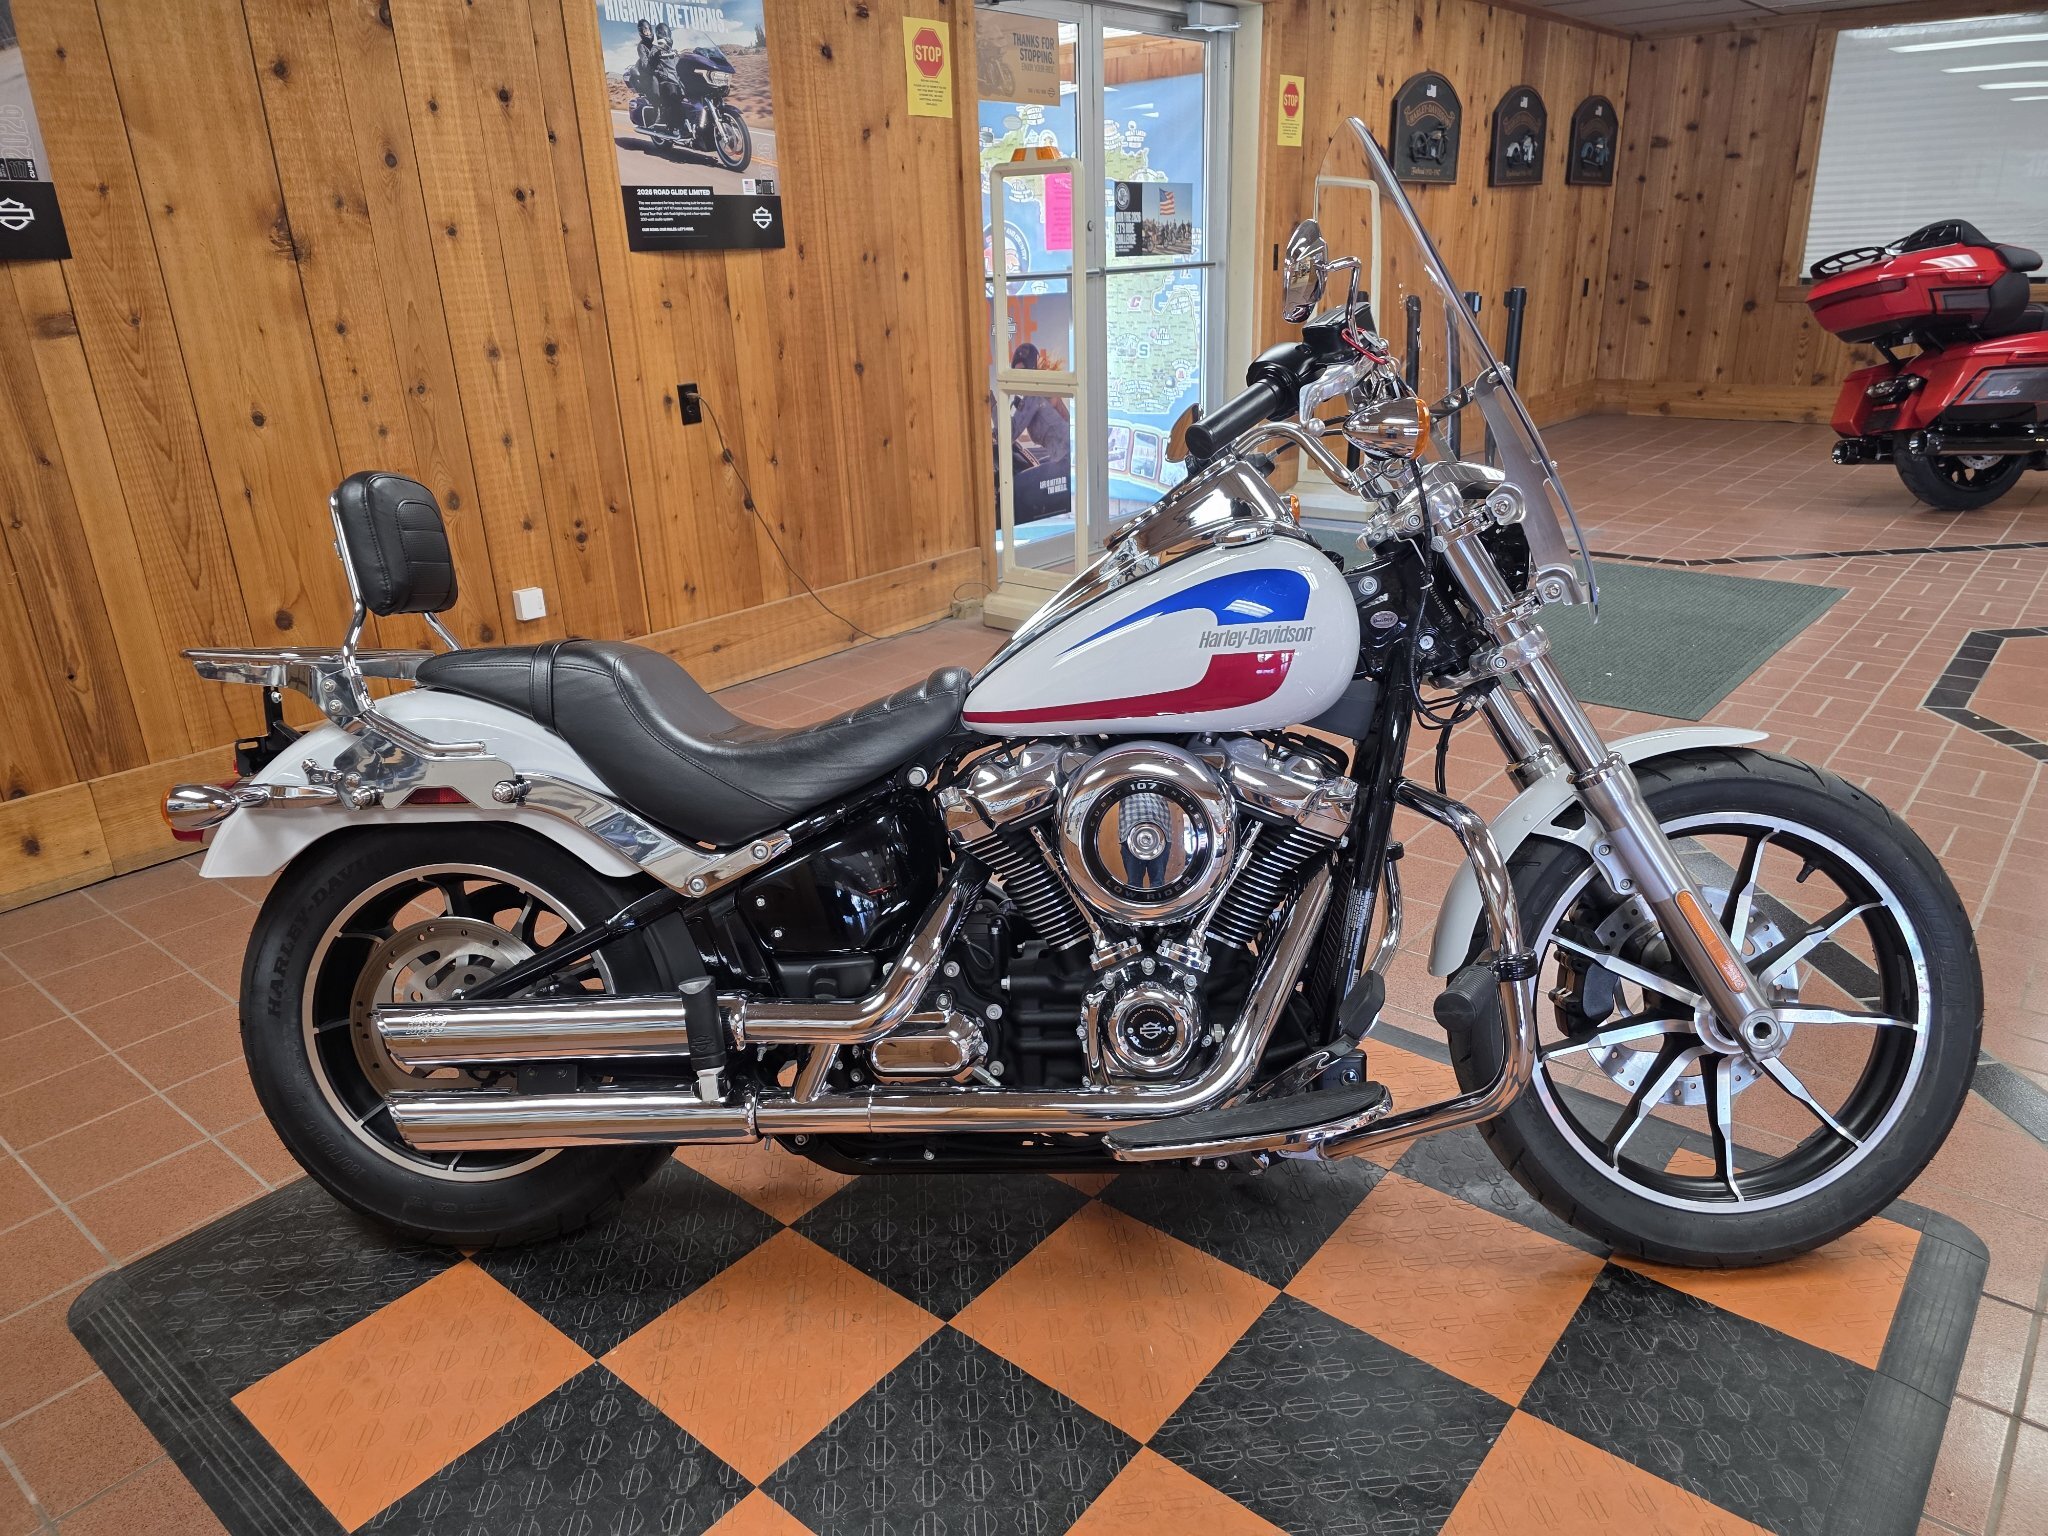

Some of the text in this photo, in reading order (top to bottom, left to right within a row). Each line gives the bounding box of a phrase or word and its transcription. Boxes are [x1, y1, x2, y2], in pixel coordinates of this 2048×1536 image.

[603, 0, 663, 25] HIGHWAY
[1012, 32, 1055, 51] THANKS FOR
[915, 44, 942, 62] STOP
[1019, 48, 1055, 65] STOPPING.
[1283, 93, 1299, 107] STOP
[1198, 625, 1313, 648] Harley-Davidson
[1130, 782, 1158, 791] 107
[1090, 786, 1204, 829] CUBIC INCHES
[1105, 876, 1192, 900] LOW RIDER
